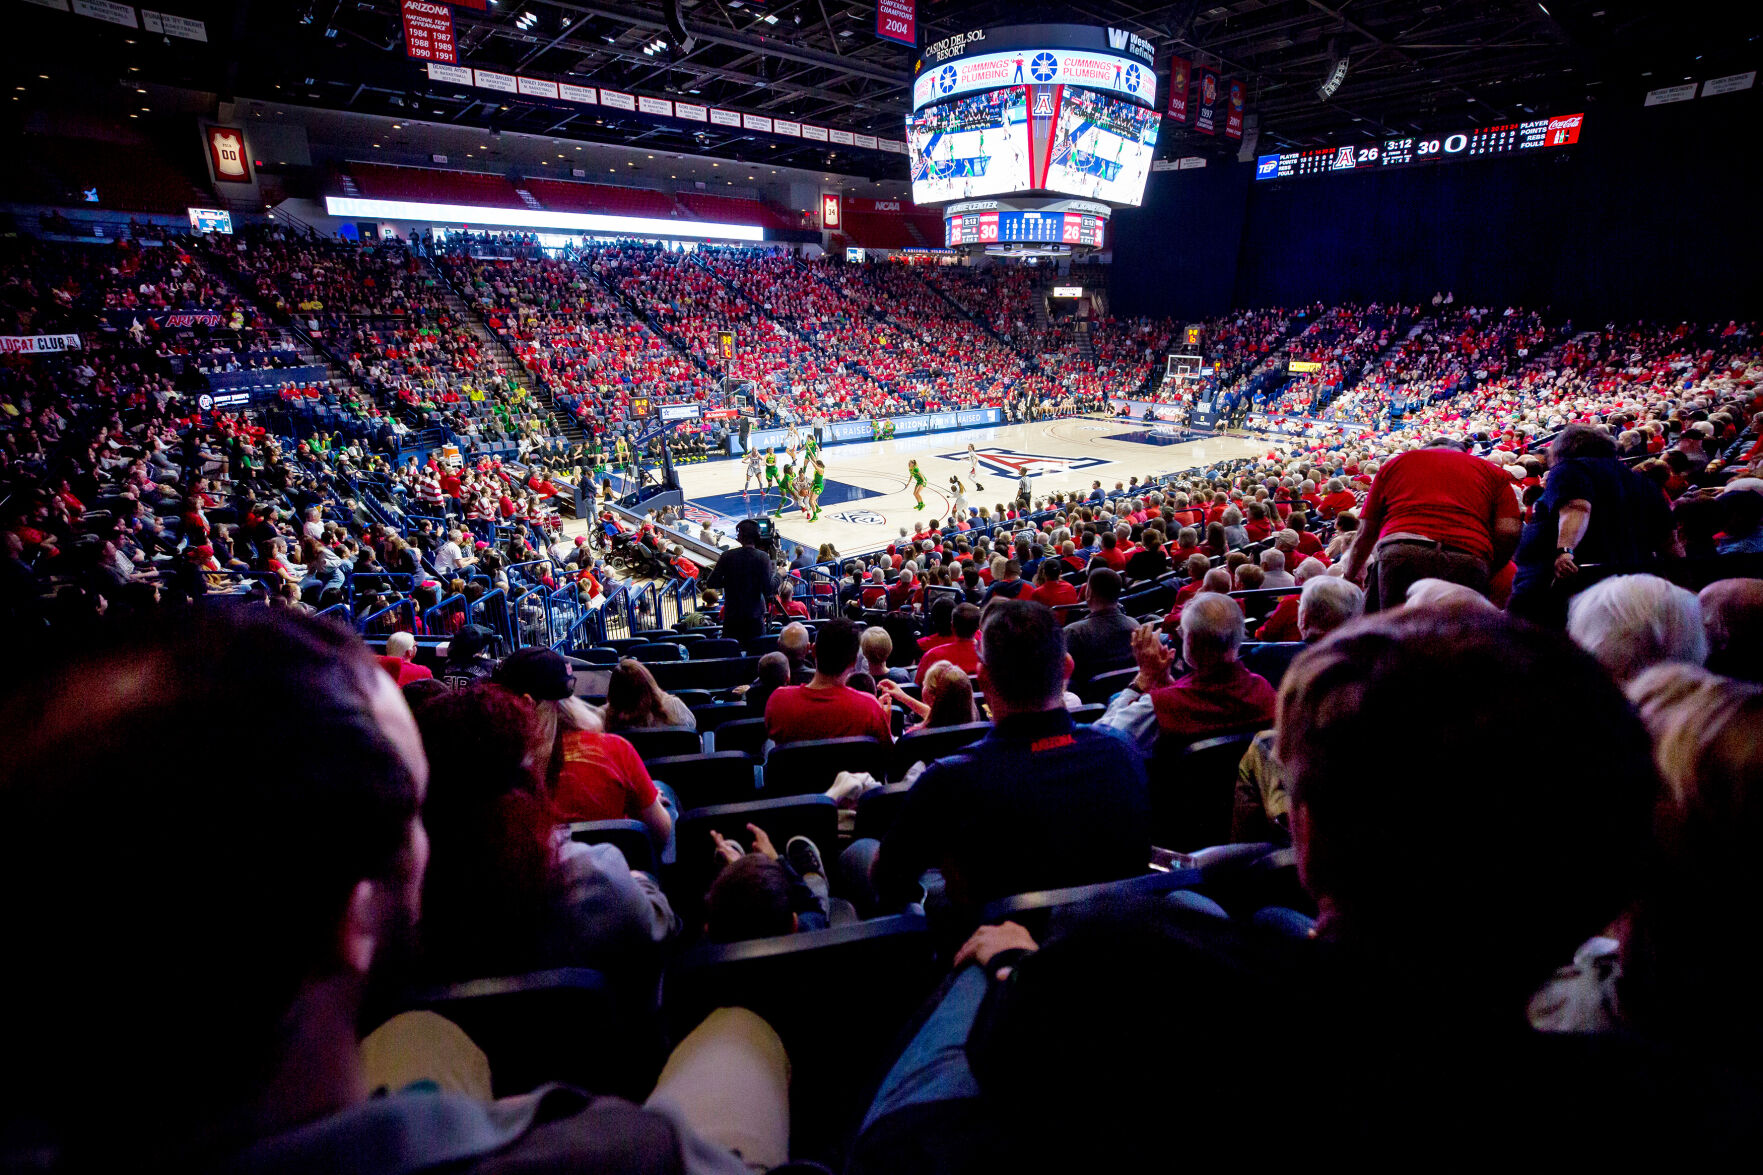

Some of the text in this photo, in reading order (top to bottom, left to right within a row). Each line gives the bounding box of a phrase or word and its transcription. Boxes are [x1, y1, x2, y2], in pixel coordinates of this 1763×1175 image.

[404, 1, 449, 16] ARIZONA
[880, 6, 912, 20] CHAMPIONS
[406, 14, 433, 23] NATIONAL
[410, 20, 446, 30] APPEARANCE
[886, 19, 908, 34] 2004
[409, 28, 450, 41] 1984 1987
[410, 38, 452, 51] 1988 1989
[926, 30, 986, 57] CASINO DEL SOL
[1130, 32, 1154, 54] Western
[412, 48, 453, 60] 1990 1991
[936, 44, 966, 62] RESORT
[1130, 43, 1154, 66] Refining
[962, 59, 1009, 74] CUMMINGS
[1064, 58, 1112, 71] CUMMINGS
[961, 69, 1009, 83] PLUMBING
[1063, 68, 1110, 80] PLUMBING
[1032, 93, 1054, 116] A
[1172, 98, 1185, 110] 1994
[1202, 108, 1212, 118] 1997
[1520, 120, 1548, 129] PLAYER
[1520, 127, 1547, 135] POINTS
[1387, 139, 1412, 150] 3:12
[1417, 140, 1440, 154] 30
[1444, 134, 1468, 153] O
[222, 150, 236, 160] 00
[1332, 146, 1356, 170] A
[1358, 148, 1378, 162] 26
[1259, 164, 1276, 174] TEP
[875, 202, 900, 210] NCAA
[952, 228, 961, 241] 26
[980, 224, 998, 239] 30
[1065, 225, 1079, 240] 26
[38, 338, 65, 350] CLUB
[895, 420, 928, 430] ARIZONA
[958, 414, 980, 423] RAISED
[843, 426, 872, 436] RAISED
